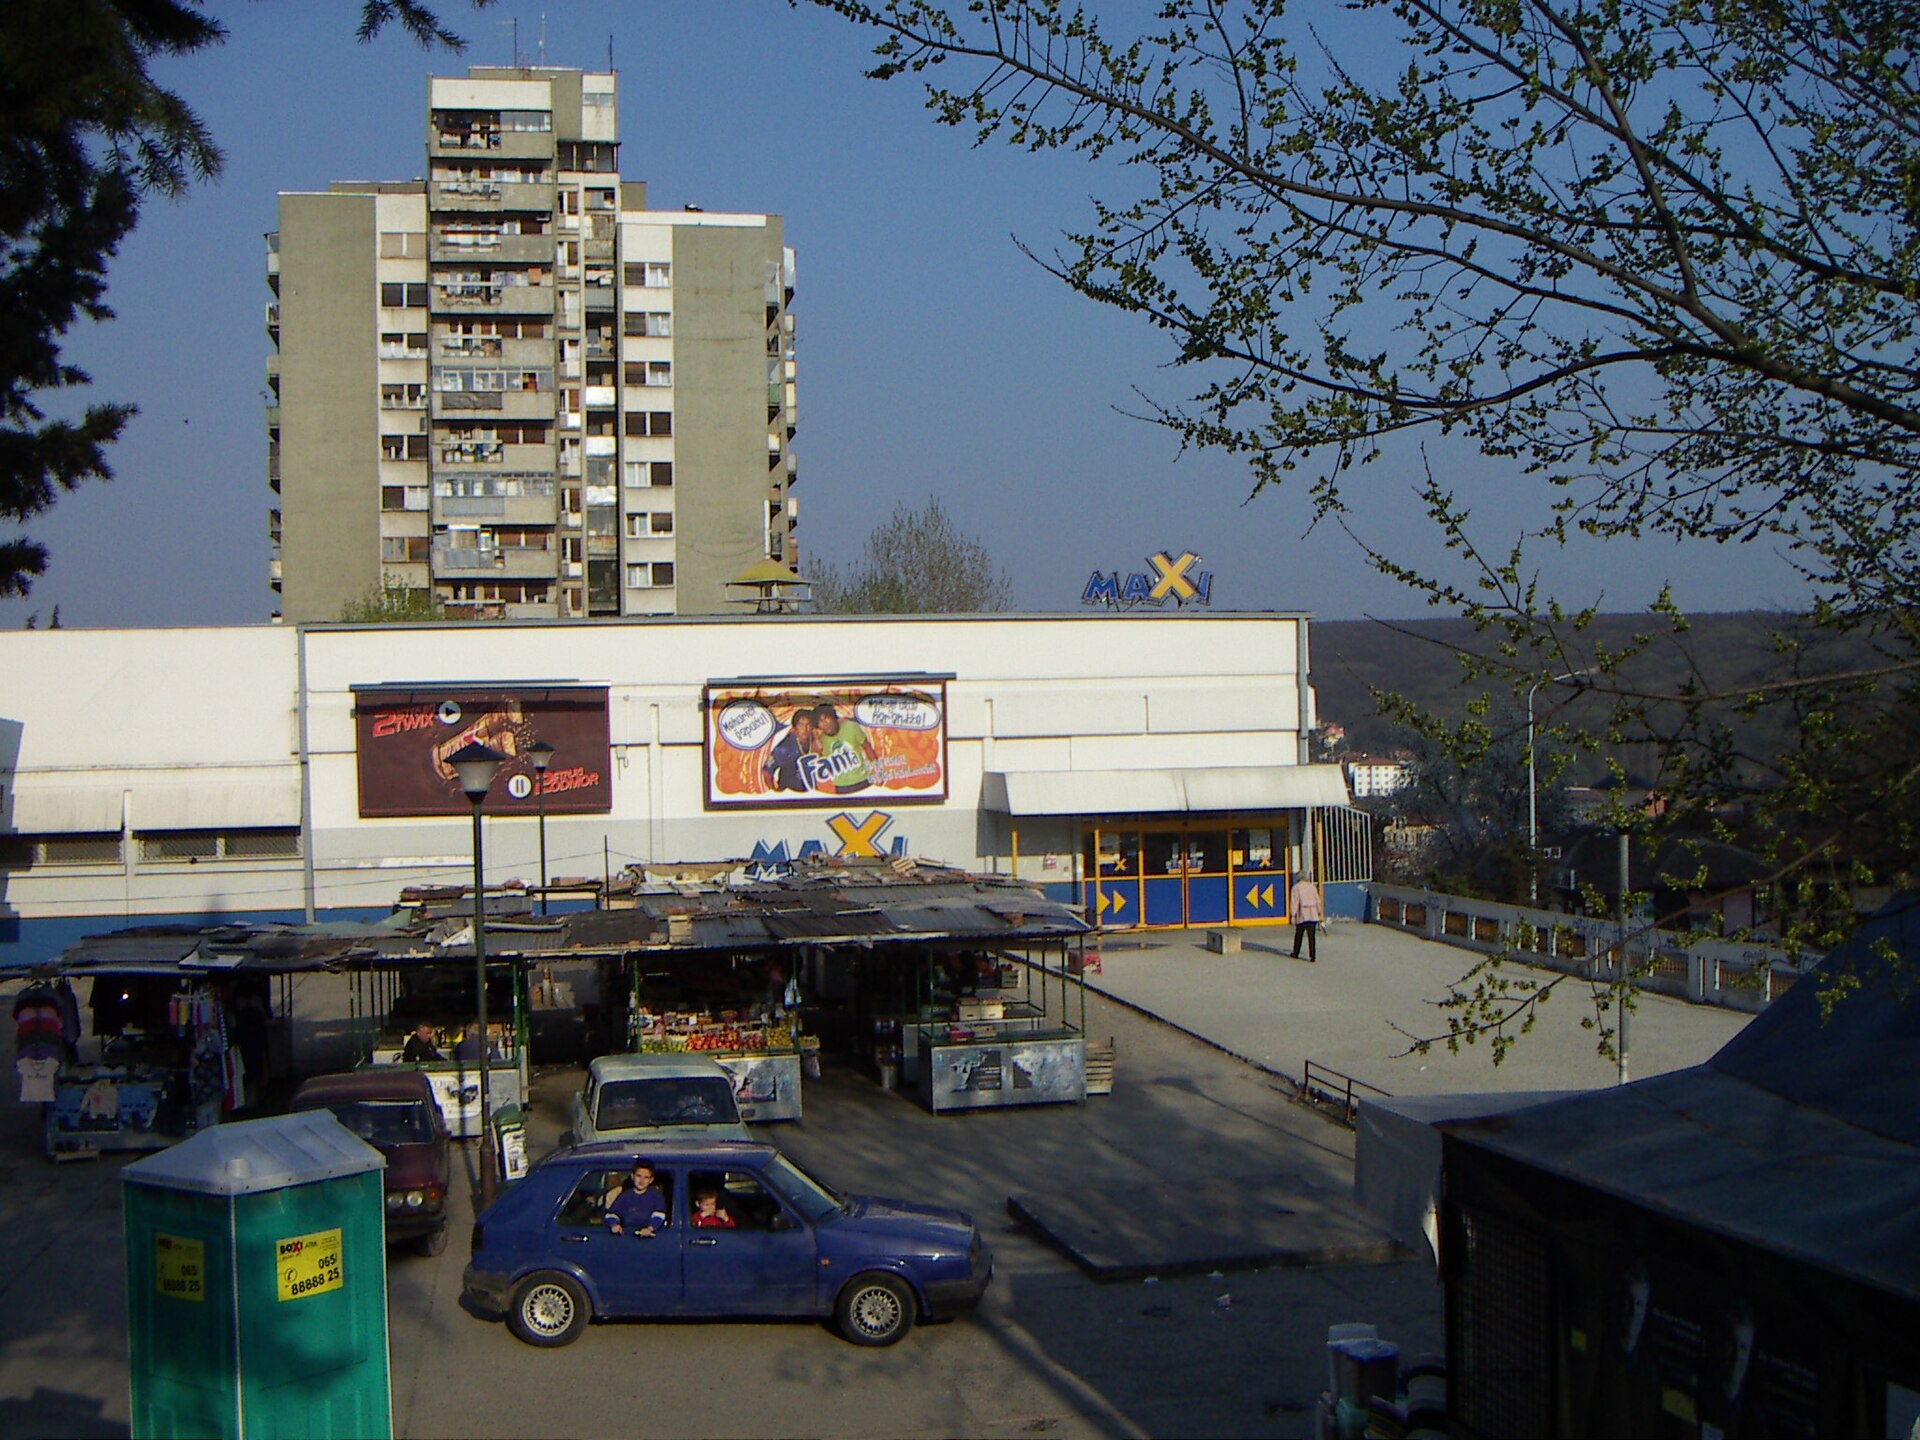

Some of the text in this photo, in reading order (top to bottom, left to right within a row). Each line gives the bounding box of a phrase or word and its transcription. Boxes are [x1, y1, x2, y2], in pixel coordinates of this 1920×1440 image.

[1081, 549, 1213, 609] MAXI
[395, 713, 435, 733] TWIX
[797, 748, 861, 791] Fanta
[743, 810, 908, 882] MAXI
[280, 1240, 303, 1254] BOXI
[291, 1267, 340, 1295] 88888 25
